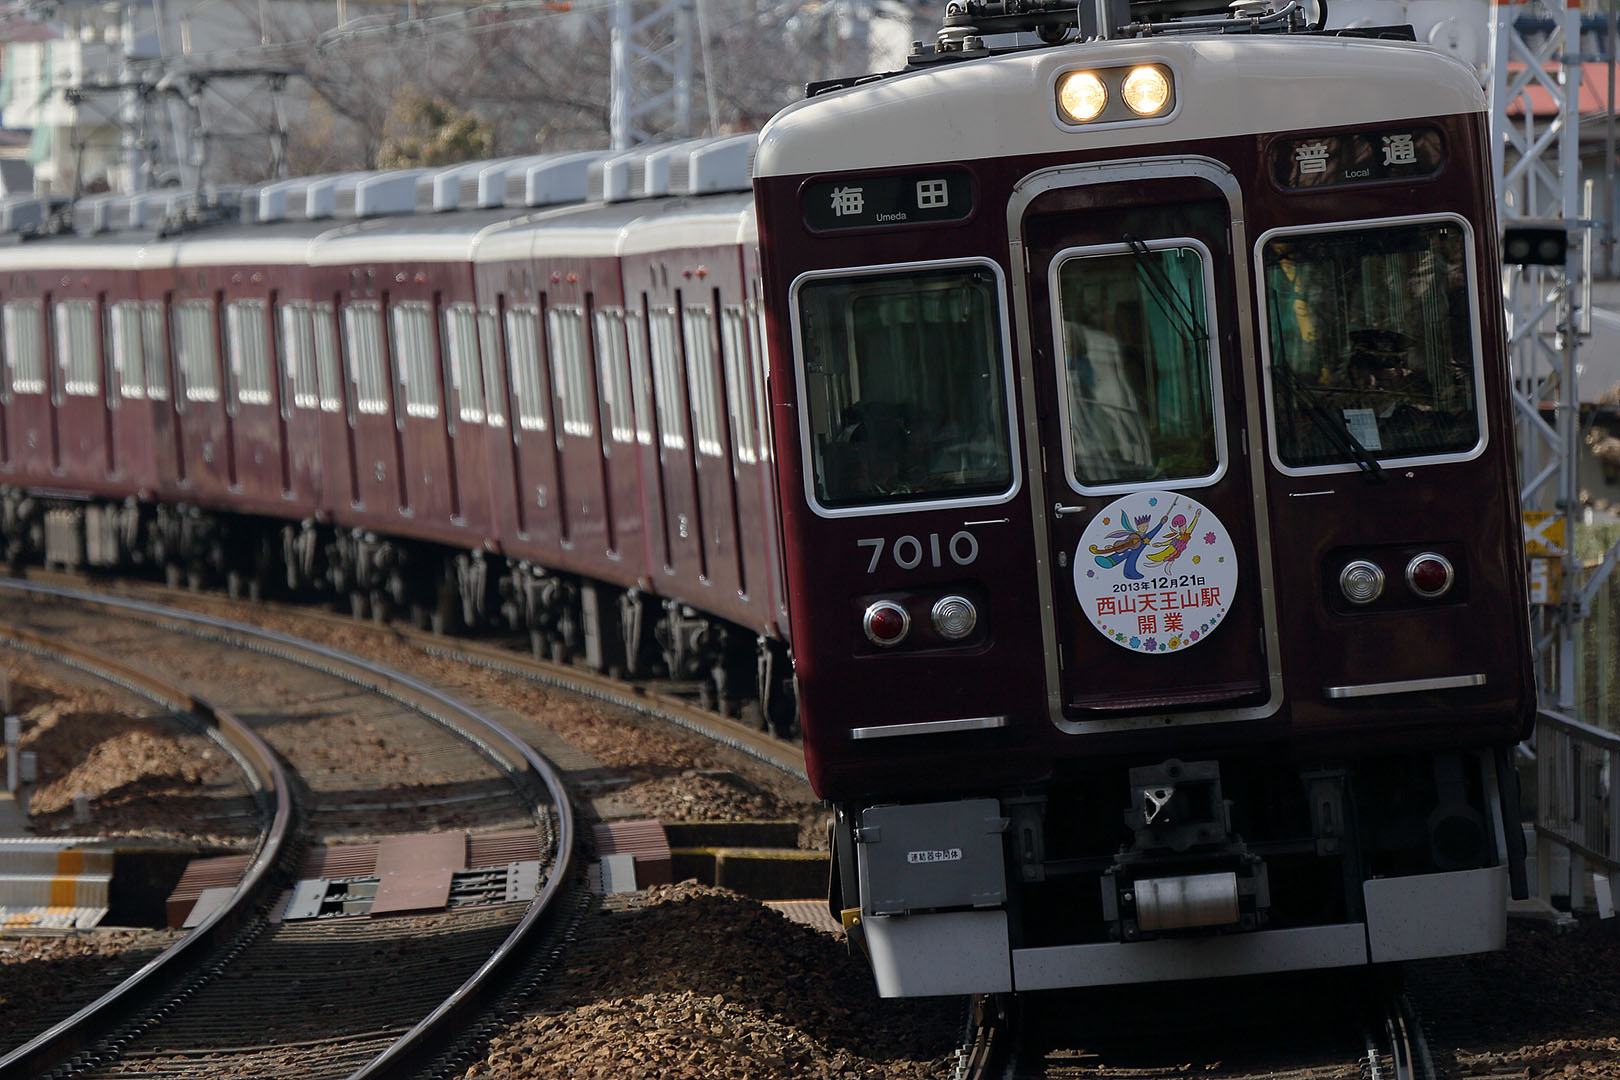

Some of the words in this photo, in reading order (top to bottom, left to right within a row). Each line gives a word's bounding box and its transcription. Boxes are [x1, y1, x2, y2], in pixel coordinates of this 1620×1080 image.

[1296, 134, 1417, 174] 普通
[1346, 168, 1370, 178] Local
[831, 179, 949, 217] 梅田
[876, 212, 907, 222] Umeda
[857, 531, 979, 573] 7010
[1113, 575, 1206, 593] 2013年12月21日
[1096, 587, 1222, 617] 西山天王山駅
[1138, 612, 1184, 635] 開業
